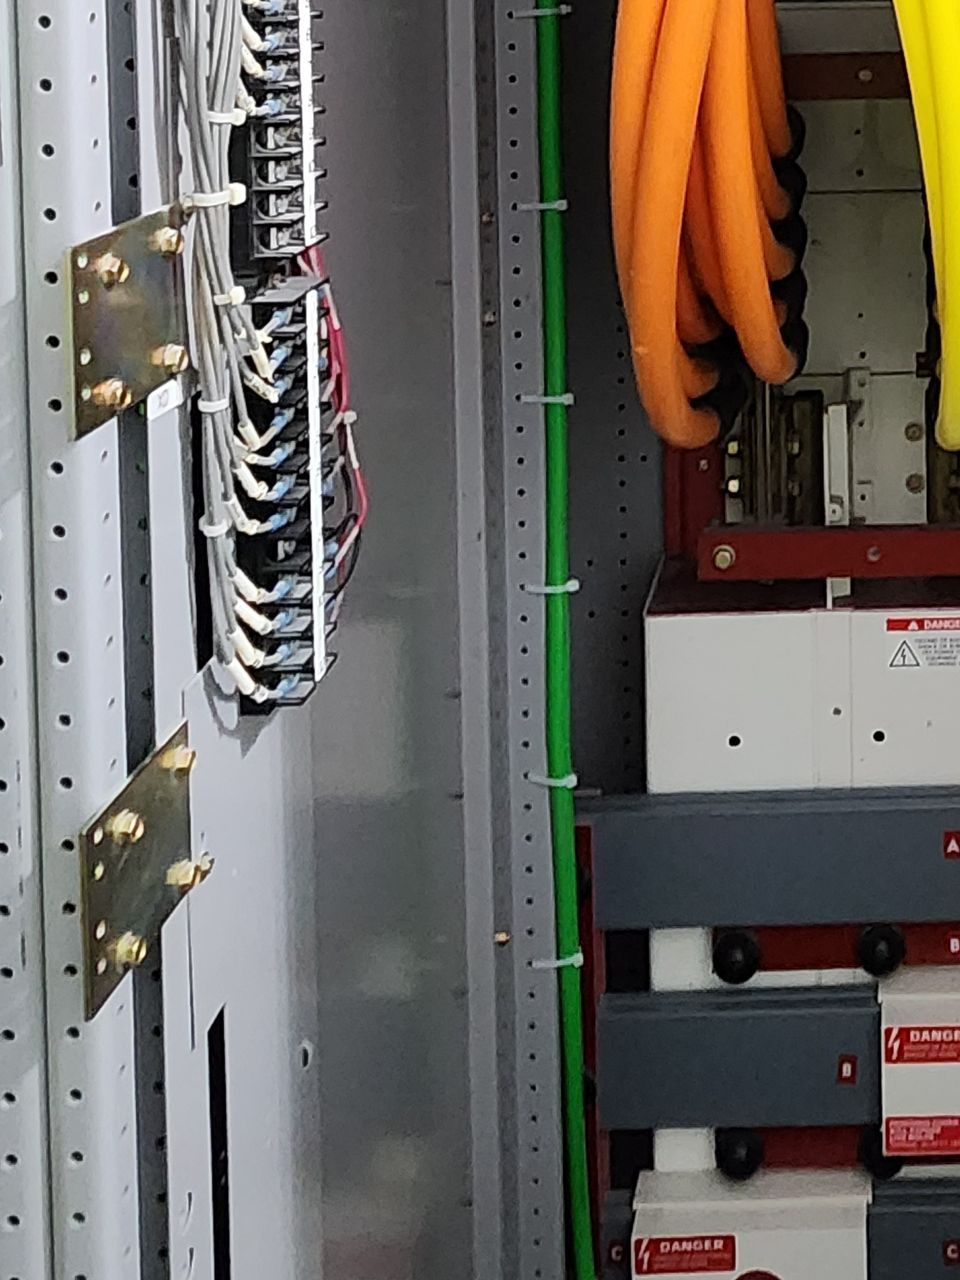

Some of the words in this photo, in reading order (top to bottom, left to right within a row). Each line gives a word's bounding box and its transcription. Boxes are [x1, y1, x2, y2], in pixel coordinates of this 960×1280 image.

[947, 837, 960, 853] A
[949, 938, 960, 953] B
[611, 1246, 622, 1261] C
[660, 1239, 723, 1253] DANGER
[947, 1244, 958, 1259] C
